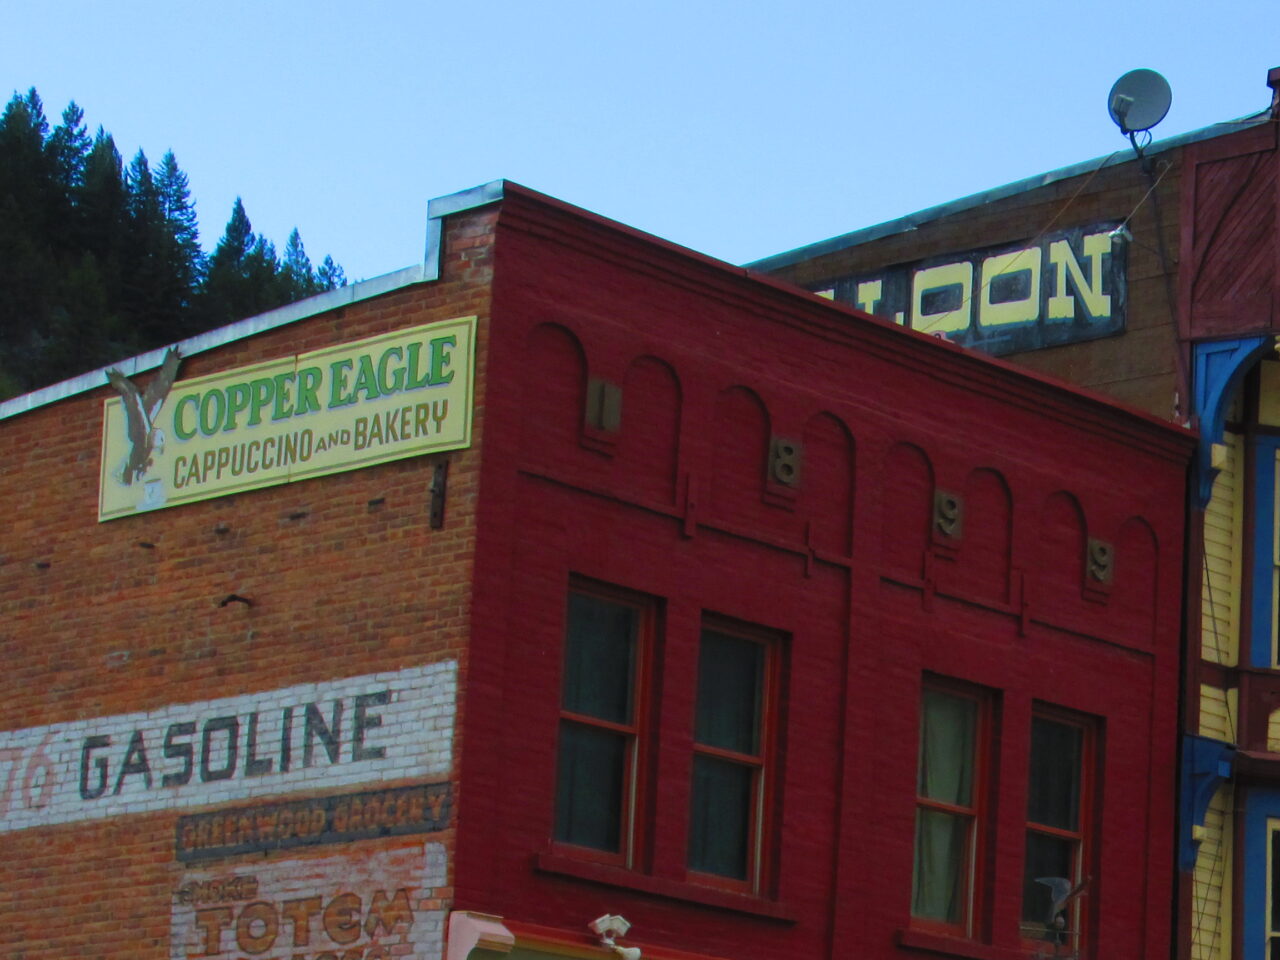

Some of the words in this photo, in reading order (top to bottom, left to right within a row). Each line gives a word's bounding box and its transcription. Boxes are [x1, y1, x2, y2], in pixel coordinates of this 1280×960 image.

[173, 365, 323, 441] COPPER
[328, 335, 456, 408] EAGLE
[174, 429, 313, 489] CAPPUCCINO
[315, 429, 350, 454] AND
[354, 400, 449, 451] BAKERY
[80, 689, 395, 800] GASOLINE
[182, 808, 326, 852] GREENWOOD
[195, 887, 414, 955] TOTEM
